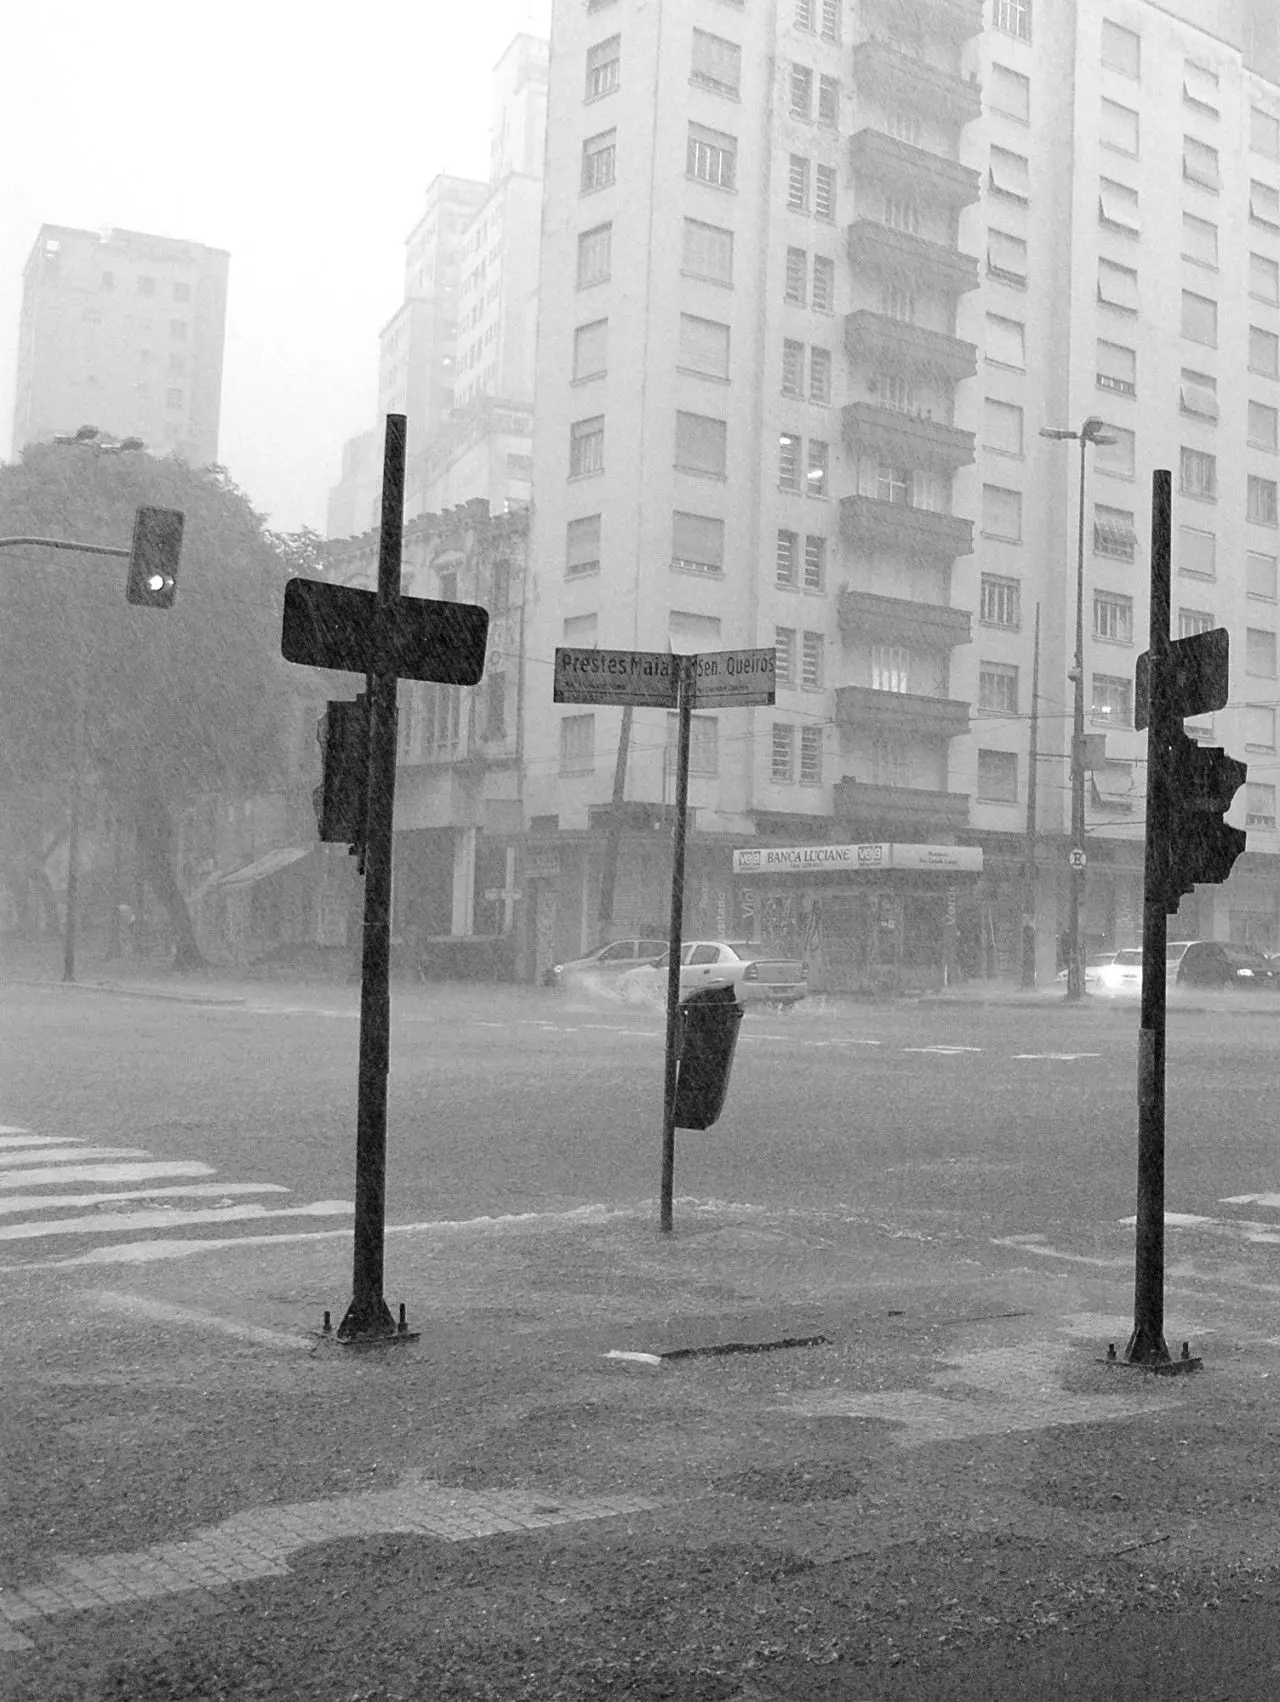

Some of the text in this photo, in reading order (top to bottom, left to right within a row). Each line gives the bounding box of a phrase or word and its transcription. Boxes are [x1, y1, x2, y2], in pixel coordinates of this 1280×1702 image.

[561, 653, 670, 677] Prestes Maia
[698, 657, 722, 677] Sen.
[767, 848, 852, 864] BANCA LUCIANE
